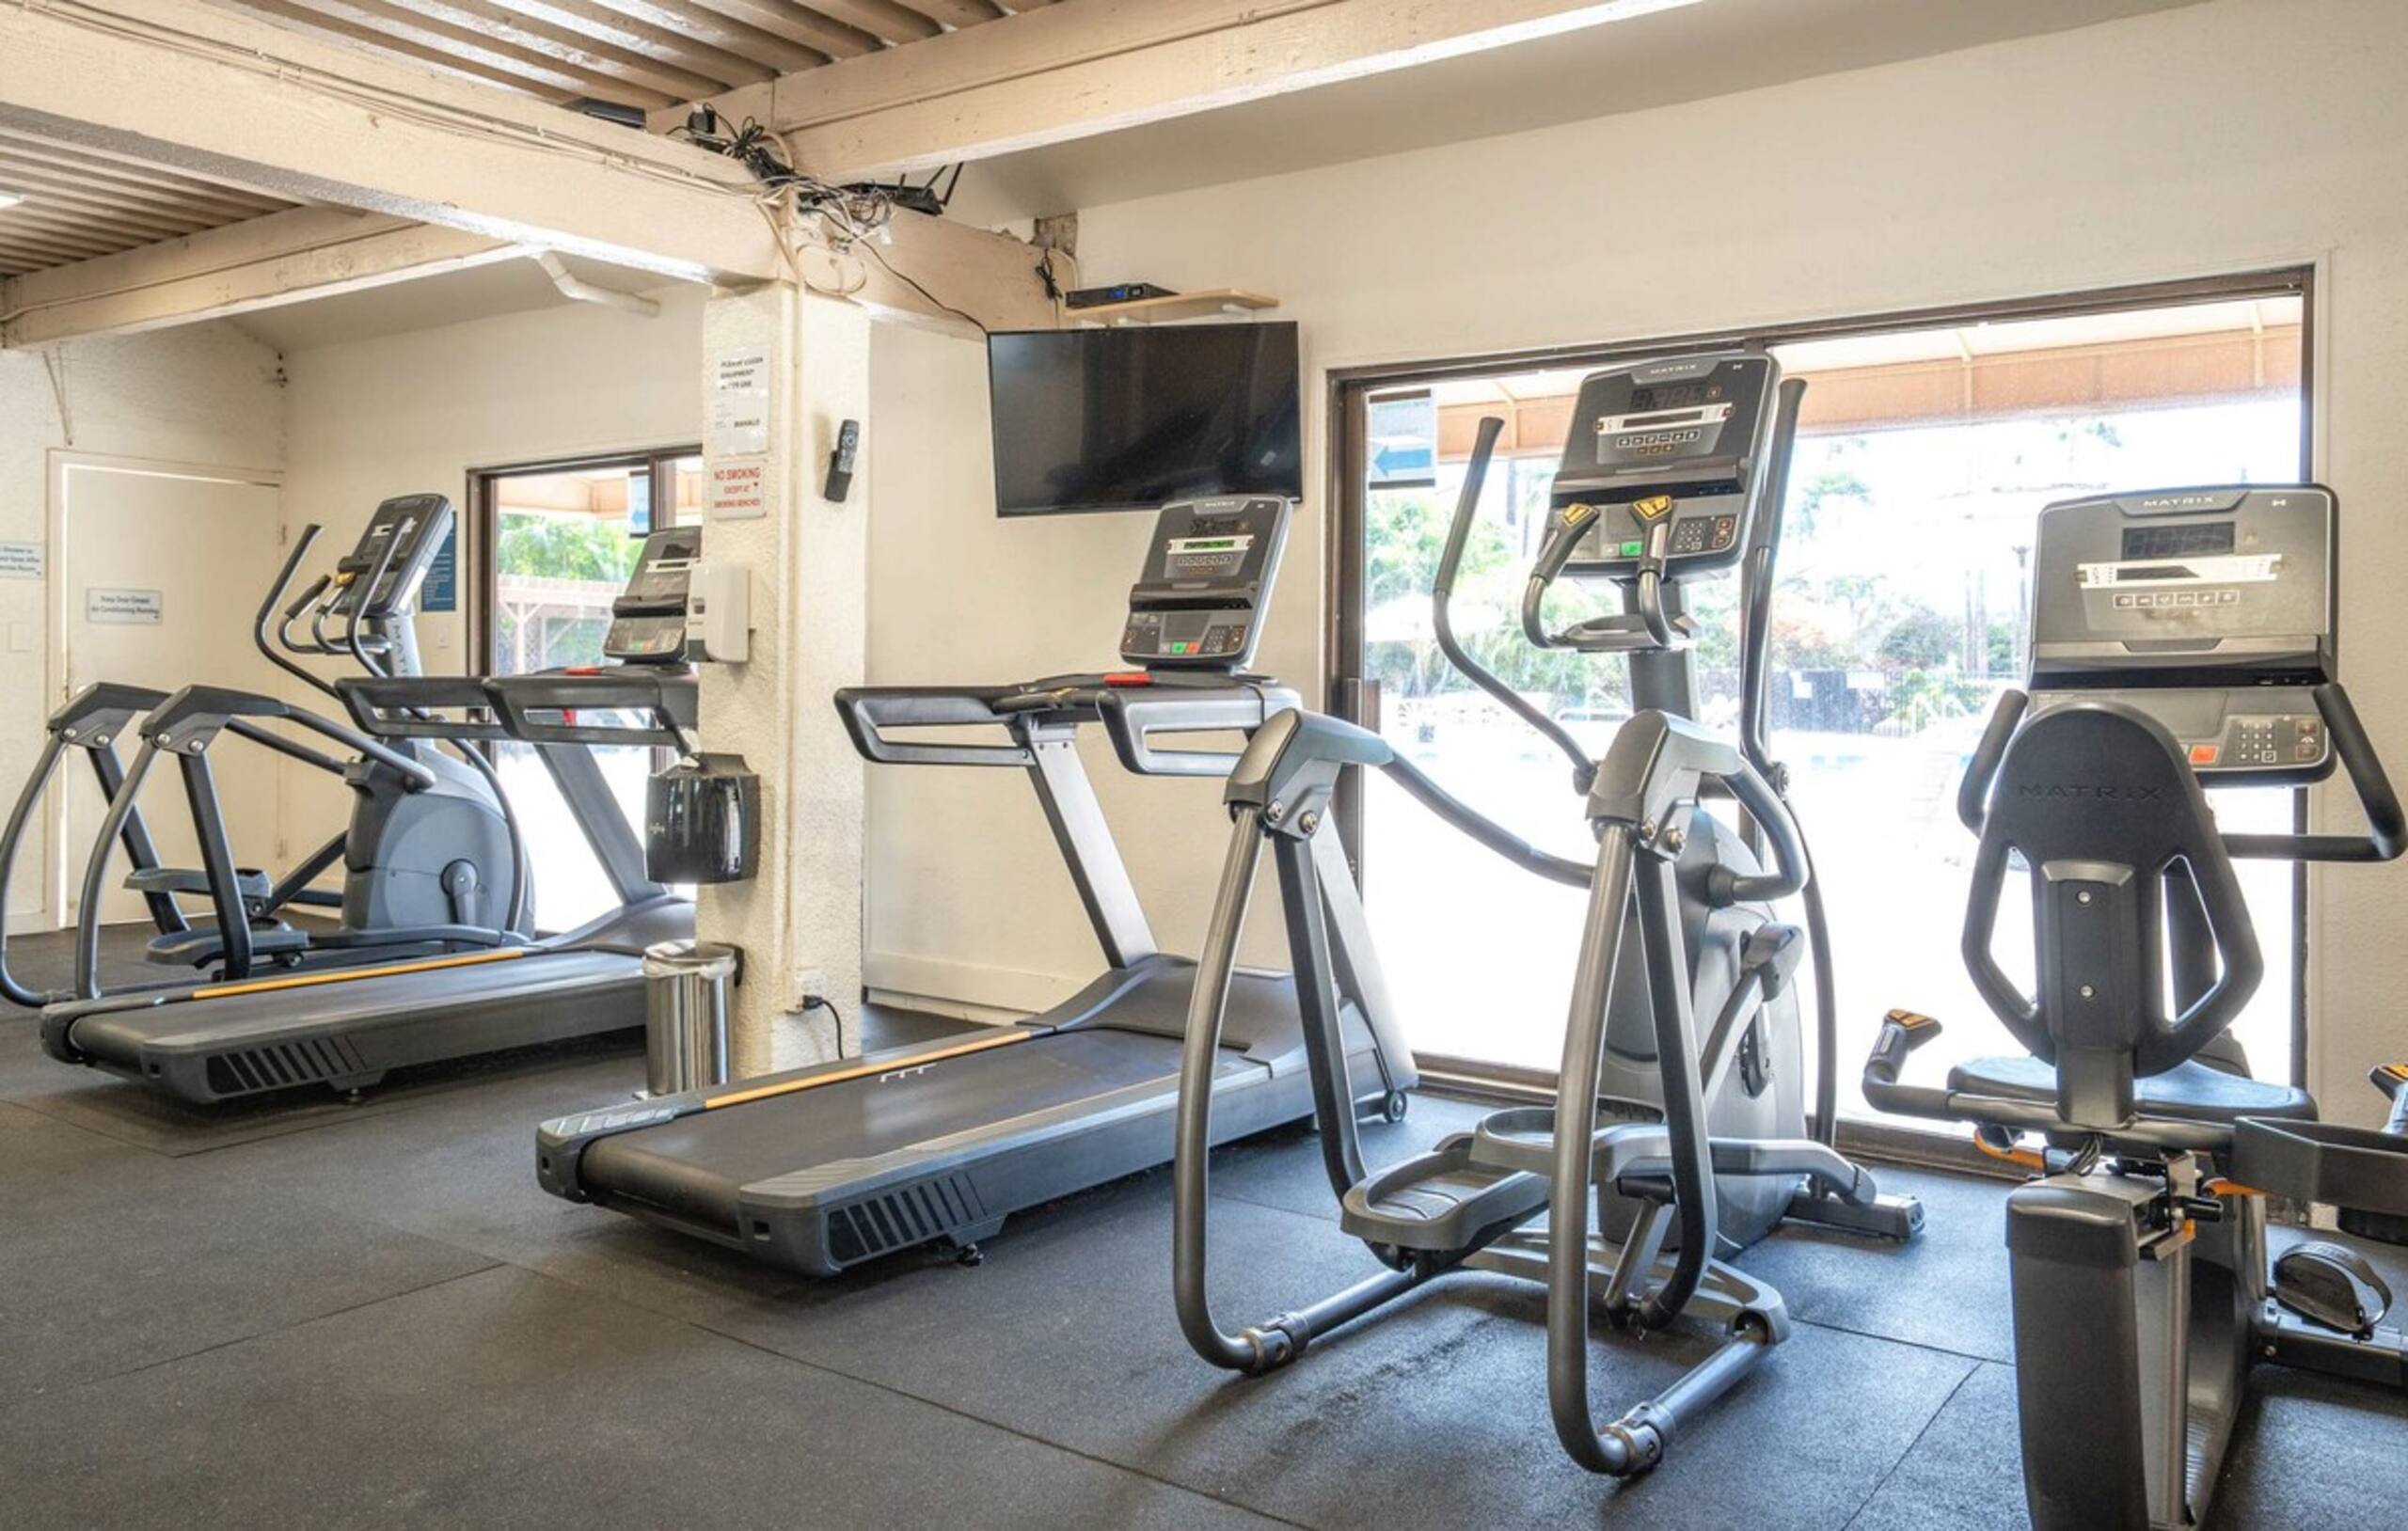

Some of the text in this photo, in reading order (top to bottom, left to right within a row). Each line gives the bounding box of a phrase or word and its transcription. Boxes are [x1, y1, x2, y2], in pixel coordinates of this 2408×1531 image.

[714, 466, 761, 481] NO SMOKING
[2144, 496, 2213, 507] MATRIX
[2020, 783, 2163, 799] MATRIX
